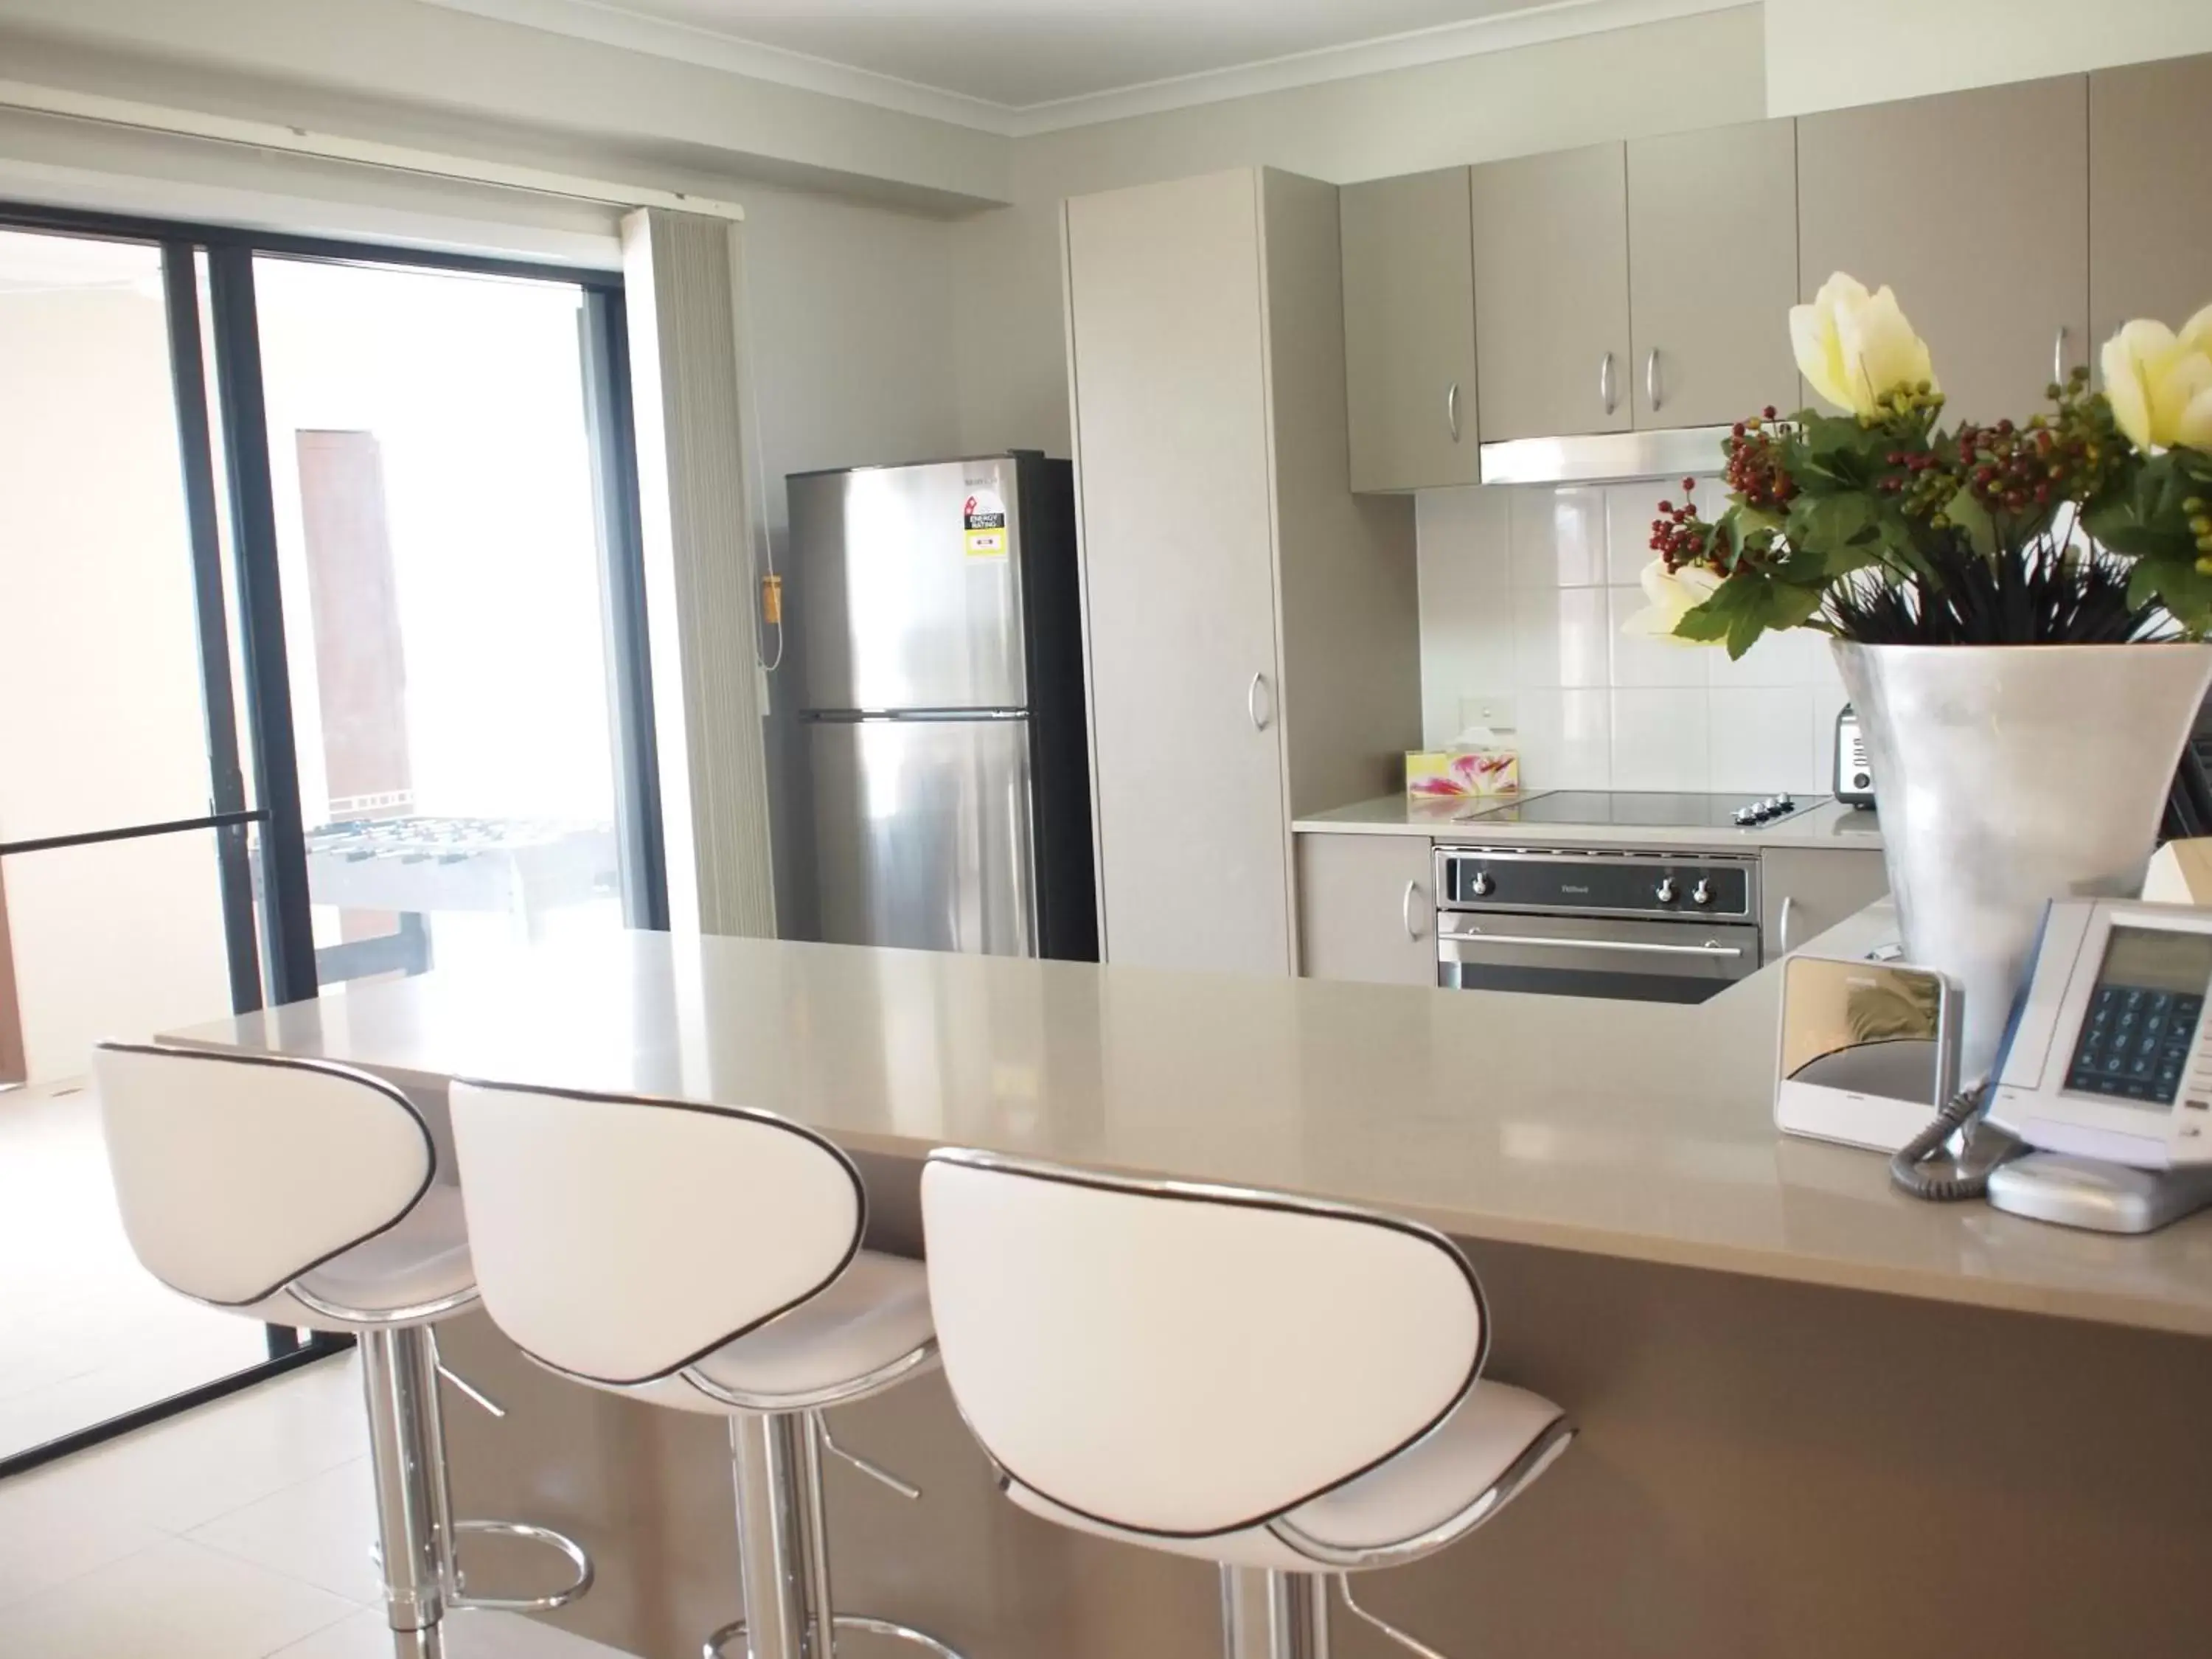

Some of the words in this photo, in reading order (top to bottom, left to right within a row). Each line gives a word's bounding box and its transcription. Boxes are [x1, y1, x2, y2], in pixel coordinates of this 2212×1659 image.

[970, 514, 997, 523] ENERGY
[971, 521, 996, 529] RATING
[2109, 1059, 2120, 1071] 0
